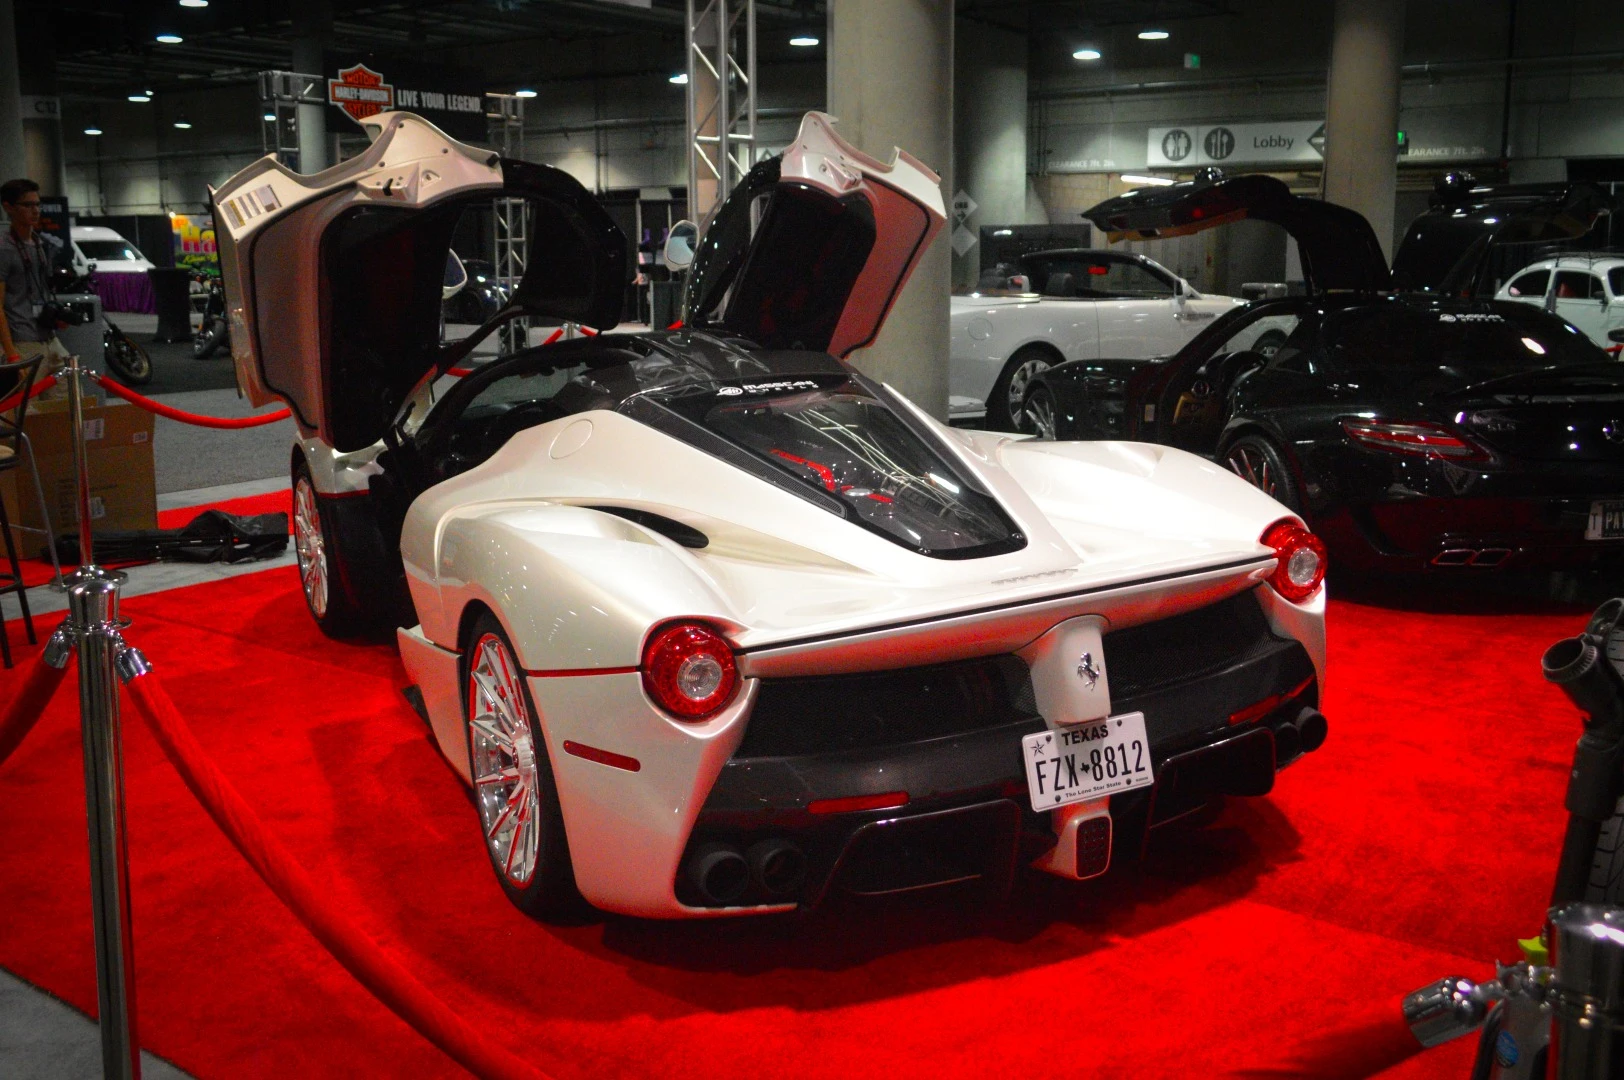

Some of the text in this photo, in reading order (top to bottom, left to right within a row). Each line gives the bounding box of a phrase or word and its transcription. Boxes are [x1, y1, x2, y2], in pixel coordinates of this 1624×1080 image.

[397, 89, 419, 107] LIVE
[421, 91, 445, 110] YOUR
[1253, 135, 1294, 150] Lobby
[1061, 724, 1109, 746] TEXAS
[1035, 739, 1146, 795] FZX 8812
[1077, 787, 1092, 795] Lone
[1093, 783, 1105, 792] Star
[1106, 781, 1122, 789] State
